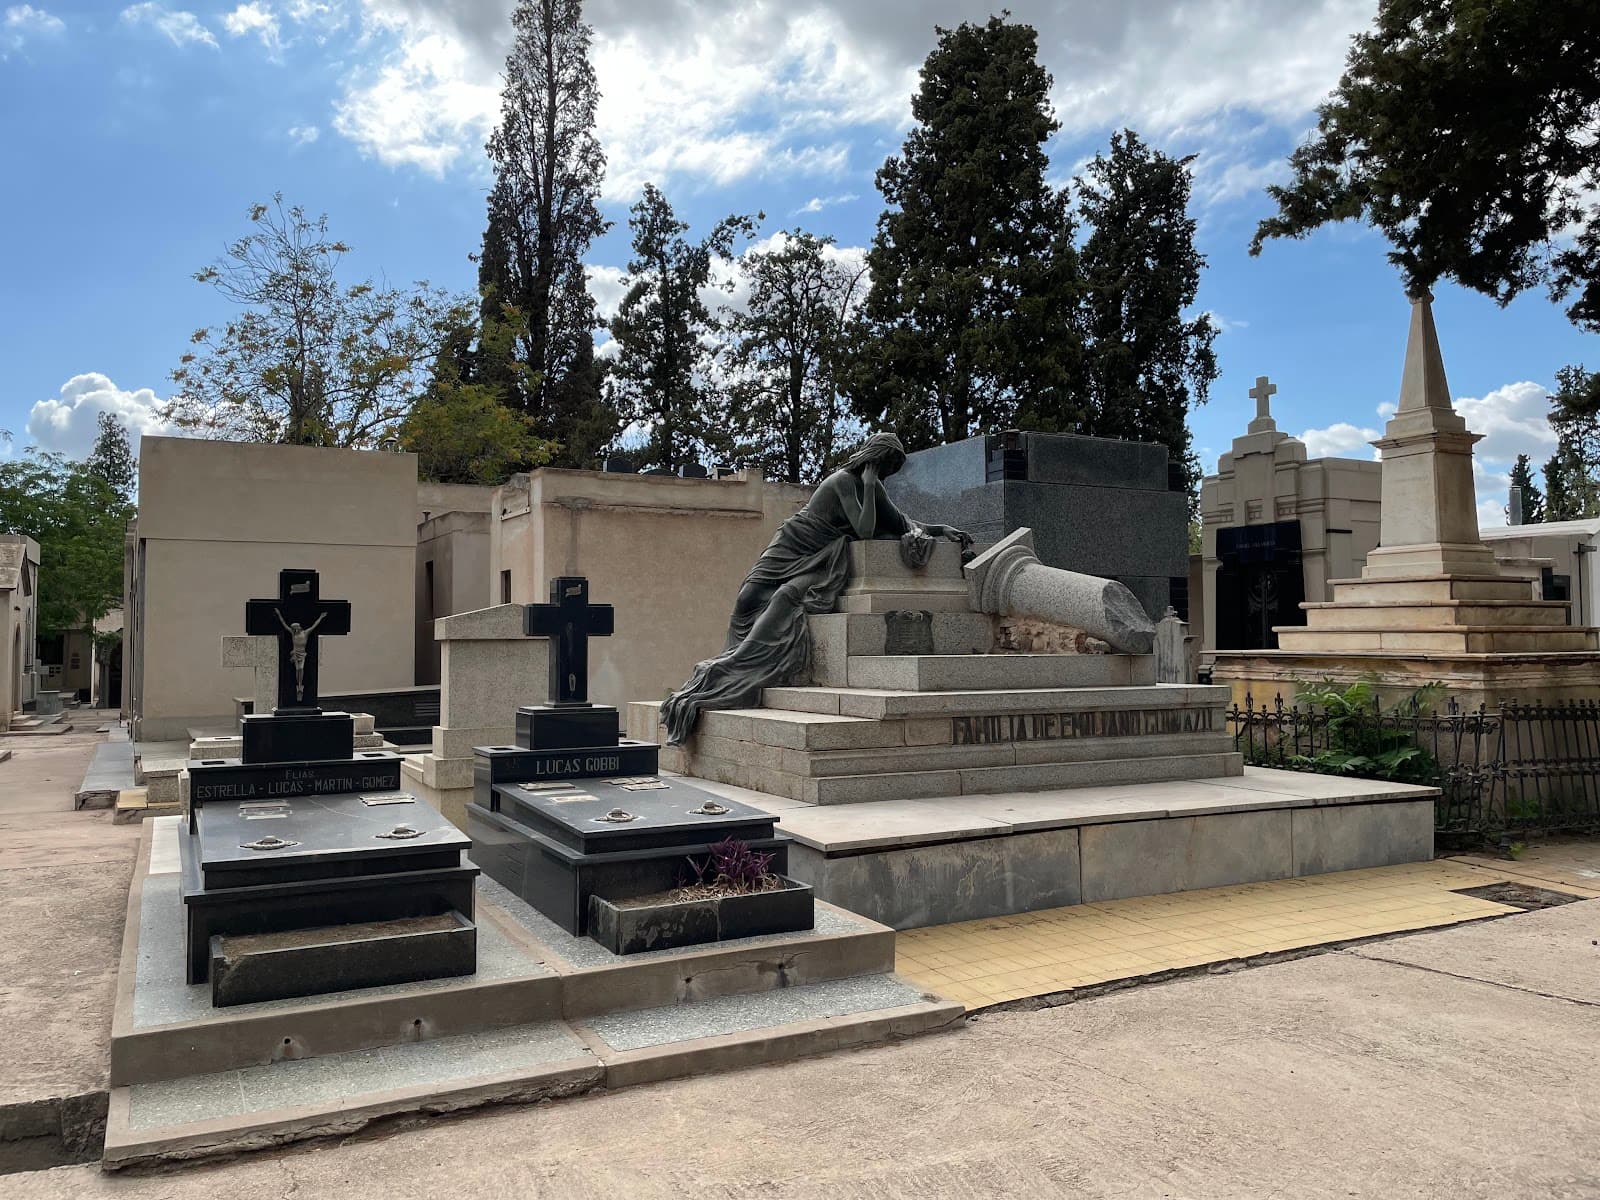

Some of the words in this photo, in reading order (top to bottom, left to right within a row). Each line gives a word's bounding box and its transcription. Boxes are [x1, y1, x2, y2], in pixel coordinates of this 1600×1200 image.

[952, 716, 1027, 744] FAMILIA
[1033, 714, 1057, 740] DE
[536, 758, 581, 775] LUCAS
[585, 756, 620, 773] GOBBI
[196, 785, 256, 799] ESTRELLA
[268, 780, 304, 795] LUCAS
[314, 777, 353, 792] MARTIN
[362, 775, 396, 789] GOMEZ
